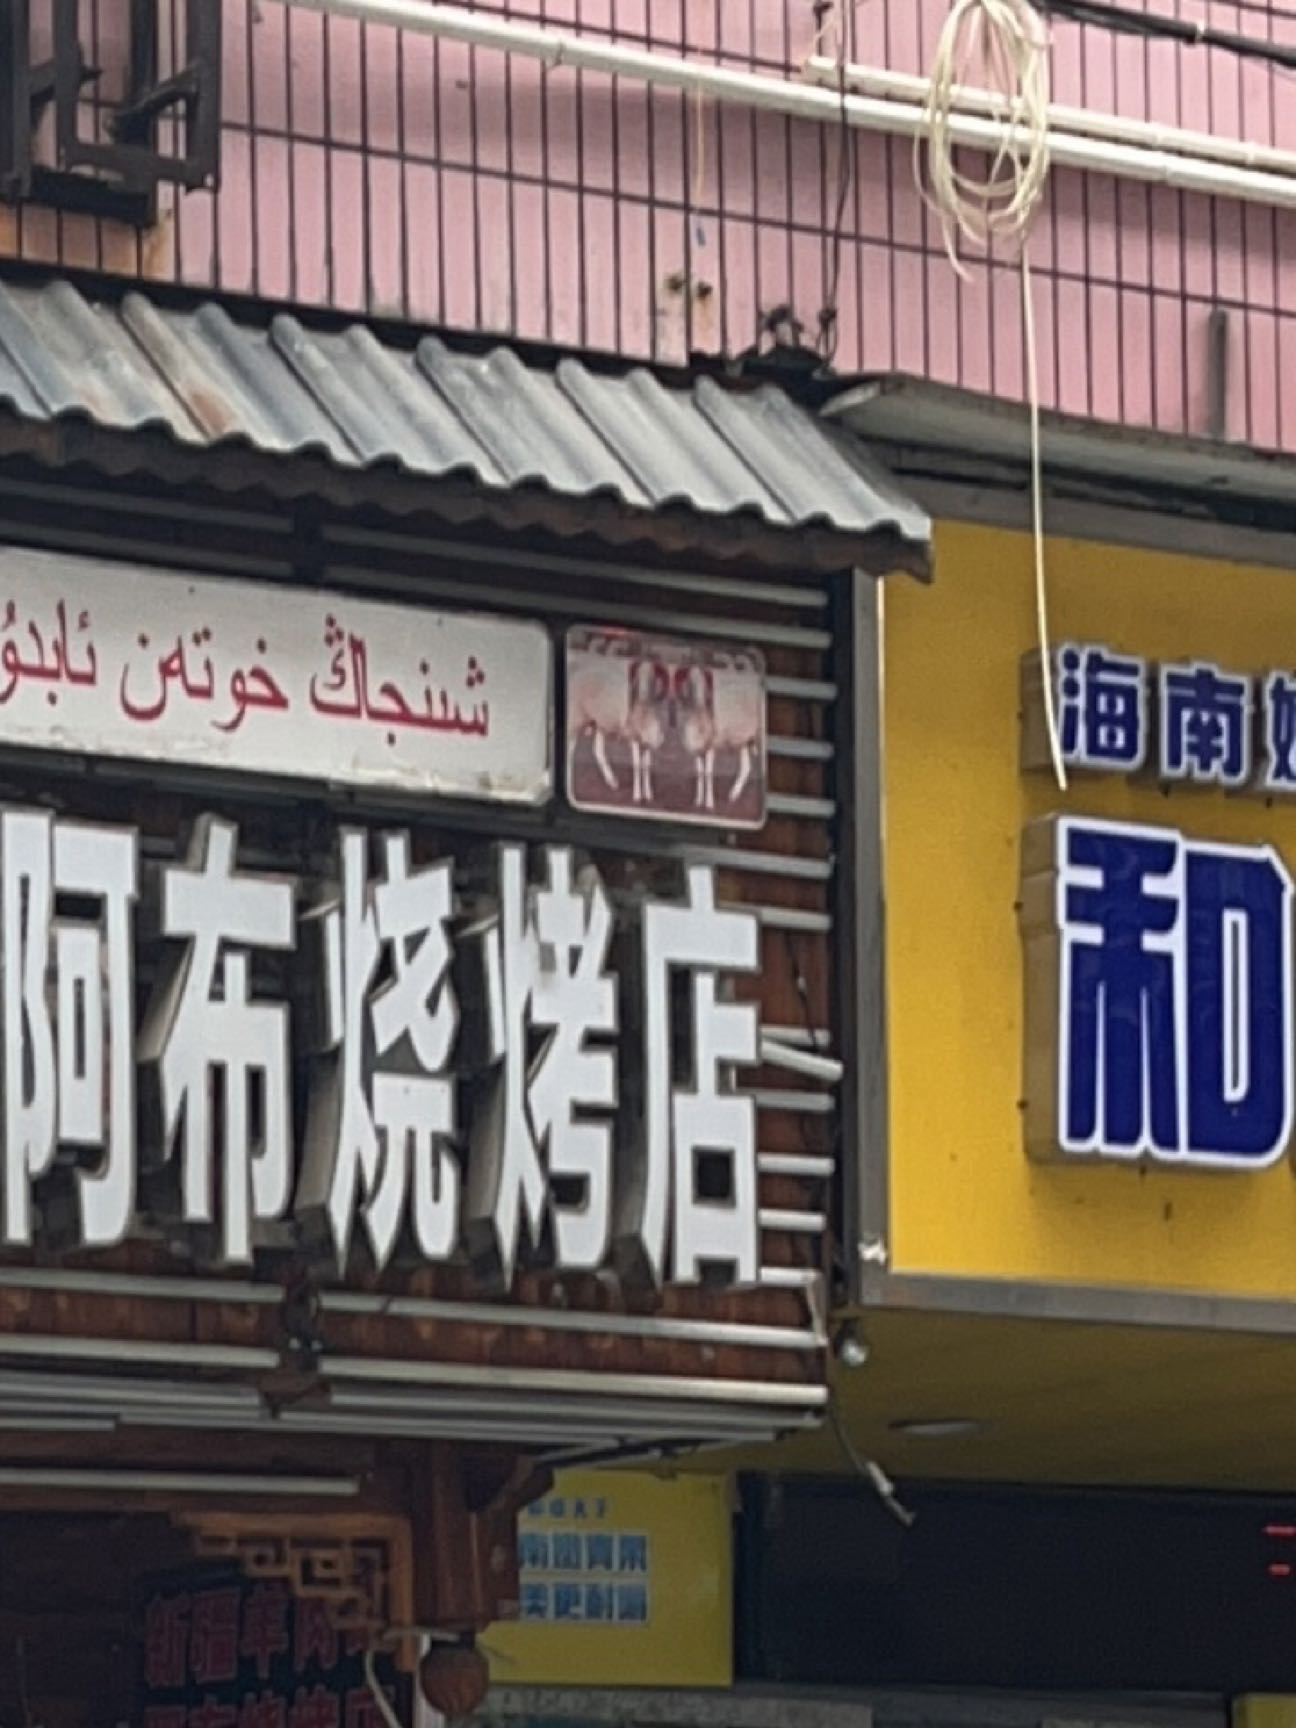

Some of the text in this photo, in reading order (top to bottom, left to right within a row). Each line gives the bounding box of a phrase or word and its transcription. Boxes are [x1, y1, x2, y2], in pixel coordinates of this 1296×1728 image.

[1057, 646, 1296, 790] 海南
[144, 1581, 372, 1688] 新疆羊肉
